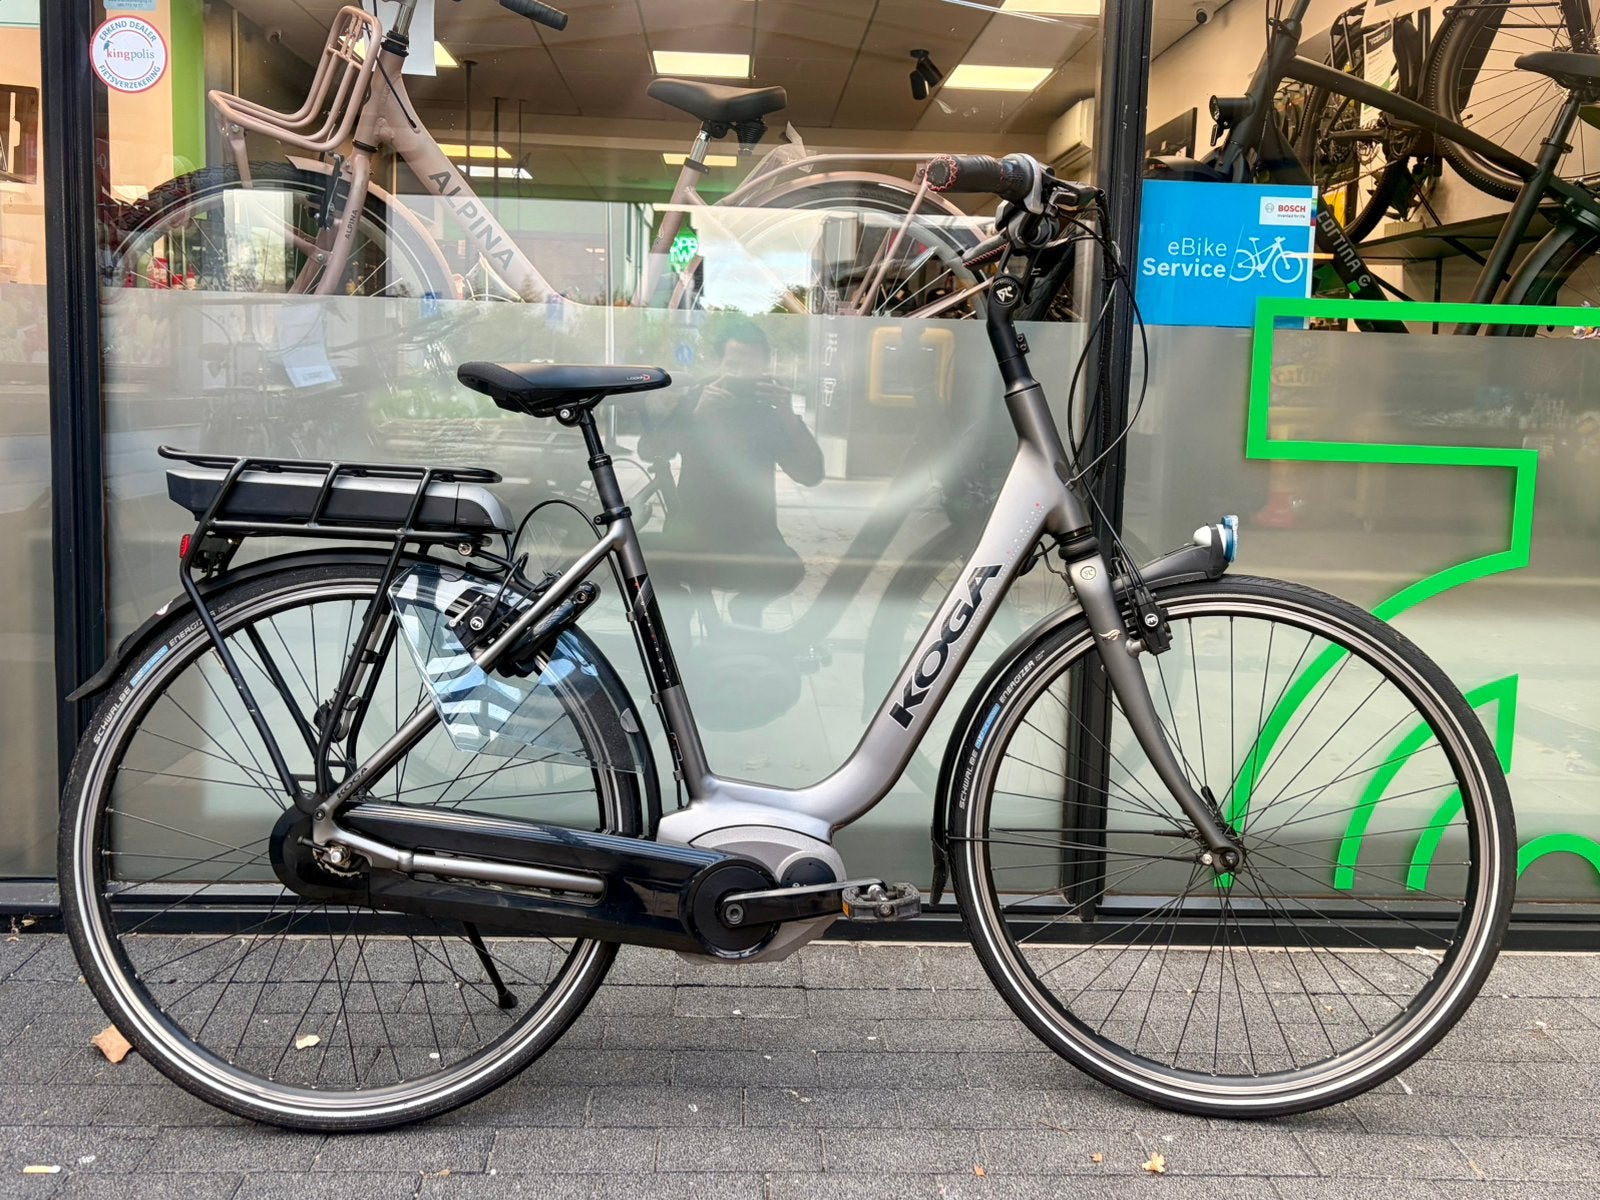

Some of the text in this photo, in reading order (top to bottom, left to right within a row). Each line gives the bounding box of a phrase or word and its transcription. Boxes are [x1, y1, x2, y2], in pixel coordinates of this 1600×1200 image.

[99, 20, 157, 42] ERKEND DEALER
[107, 48, 155, 61] kingpolis
[98, 64, 161, 89] FIETSVERZEKERING
[428, 170, 515, 271] ALPINA
[1278, 204, 1306, 212] BOSCH
[344, 209, 359, 241] ALPINA
[1167, 237, 1228, 257] eBike
[1316, 210, 1361, 273] CORTINA
[1142, 257, 1227, 279] Service
[888, 564, 1004, 731] KOGA
[999, 660, 1036, 703] ENERGIZER
[93, 686, 131, 745] SCHWALBE
[336, 767, 368, 799] KOGA
[958, 749, 979, 810] SCHWALBE
